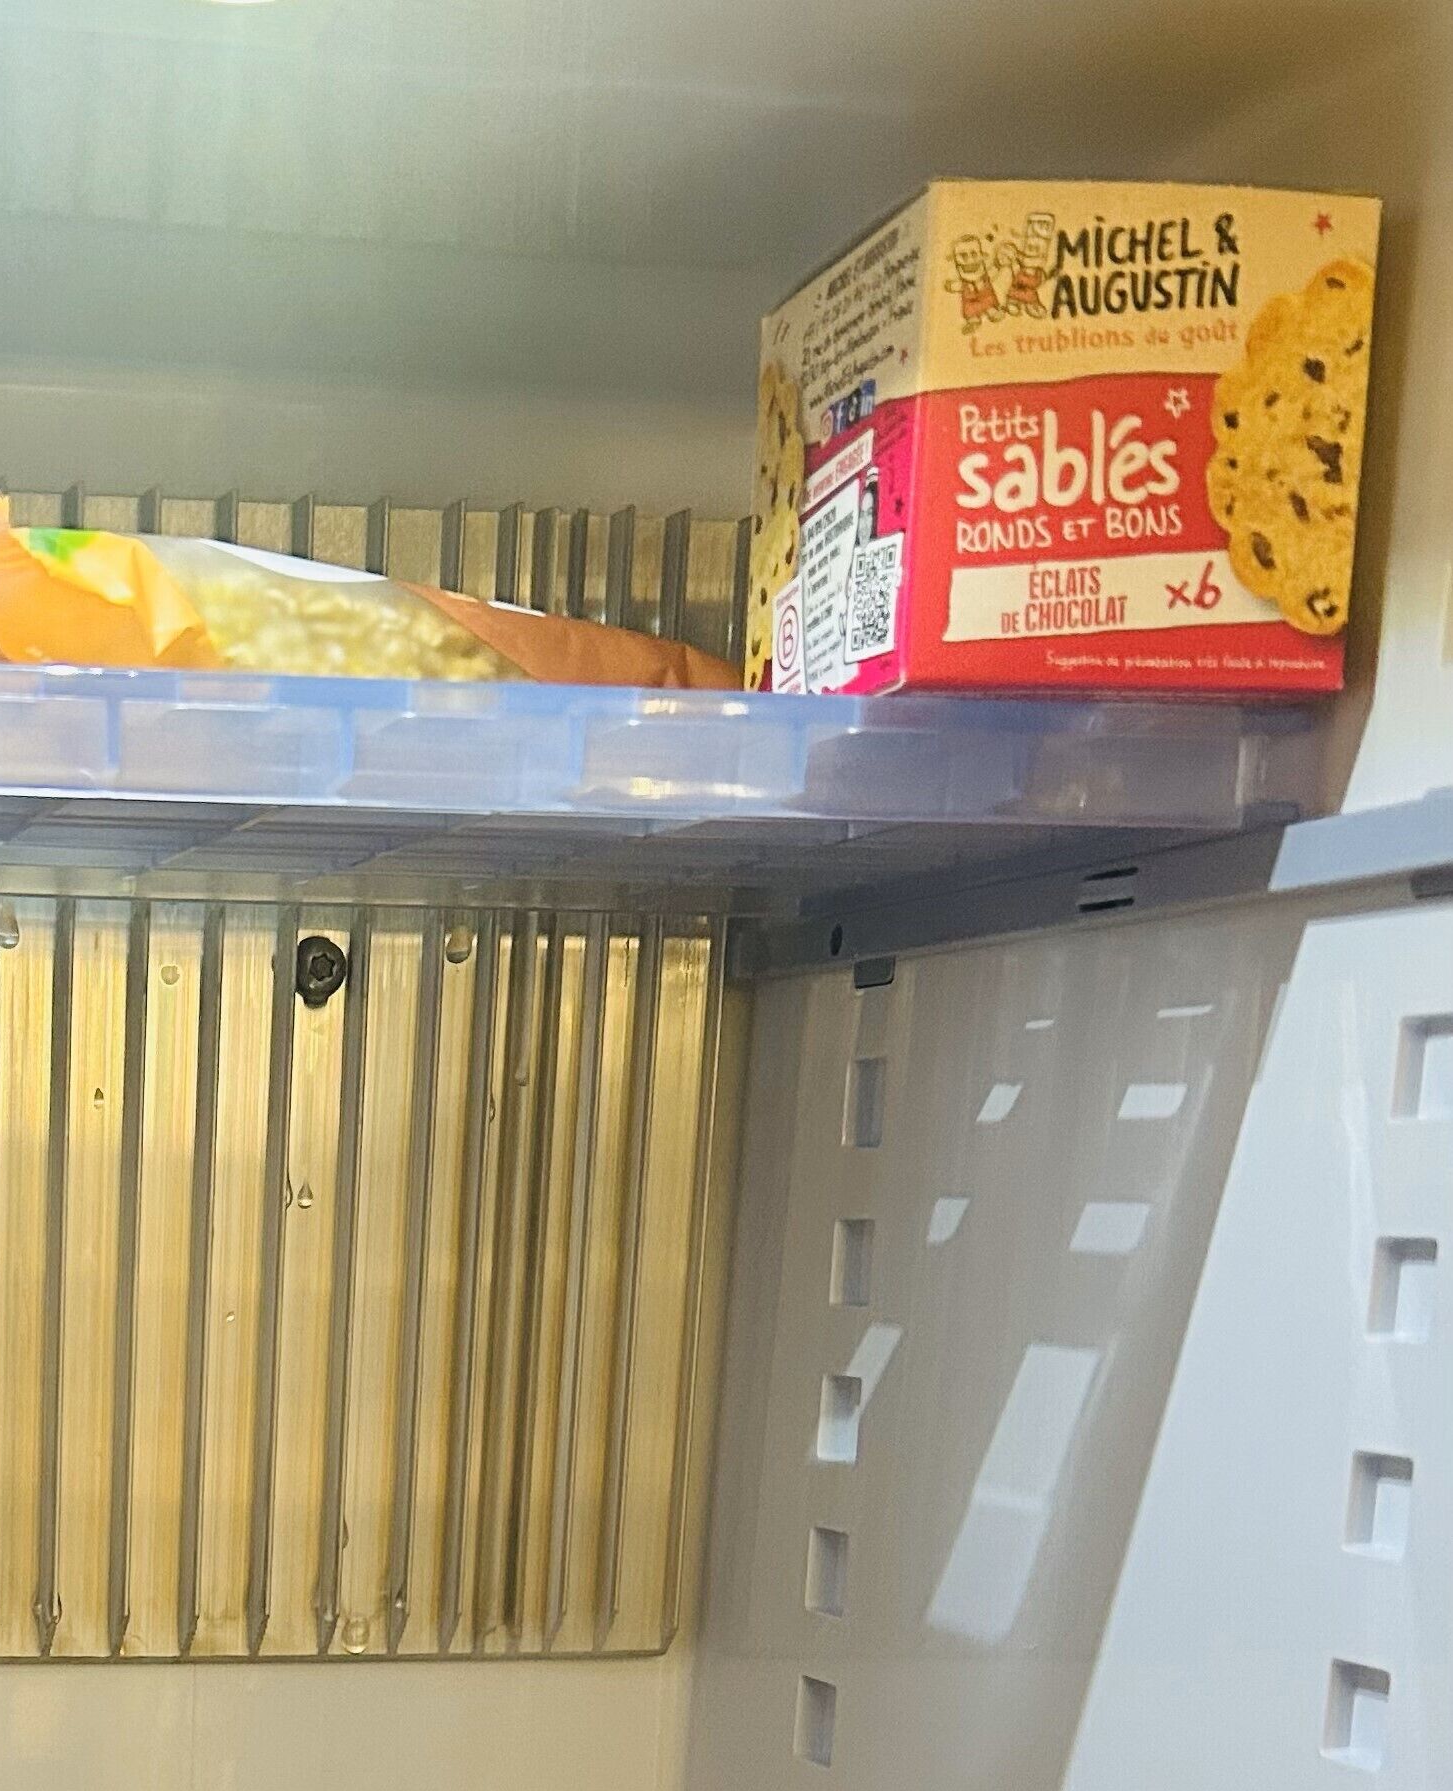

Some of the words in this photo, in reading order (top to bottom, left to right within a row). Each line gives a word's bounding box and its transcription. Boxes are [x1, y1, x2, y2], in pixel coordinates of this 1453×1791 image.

[1056, 216, 1203, 269] MICHEL
[1215, 212, 1239, 254] &
[1051, 261, 1240, 319] AUGUSTIN
[959, 404, 1039, 443] Petits
[956, 409, 1180, 513] sablés
[957, 516, 1052, 553] RONDS
[1063, 518, 1096, 541] ET
[1105, 505, 1183, 538] BONS
[1001, 612, 1020, 634] DE
[1024, 595, 1128, 632] CHOCOLAT
